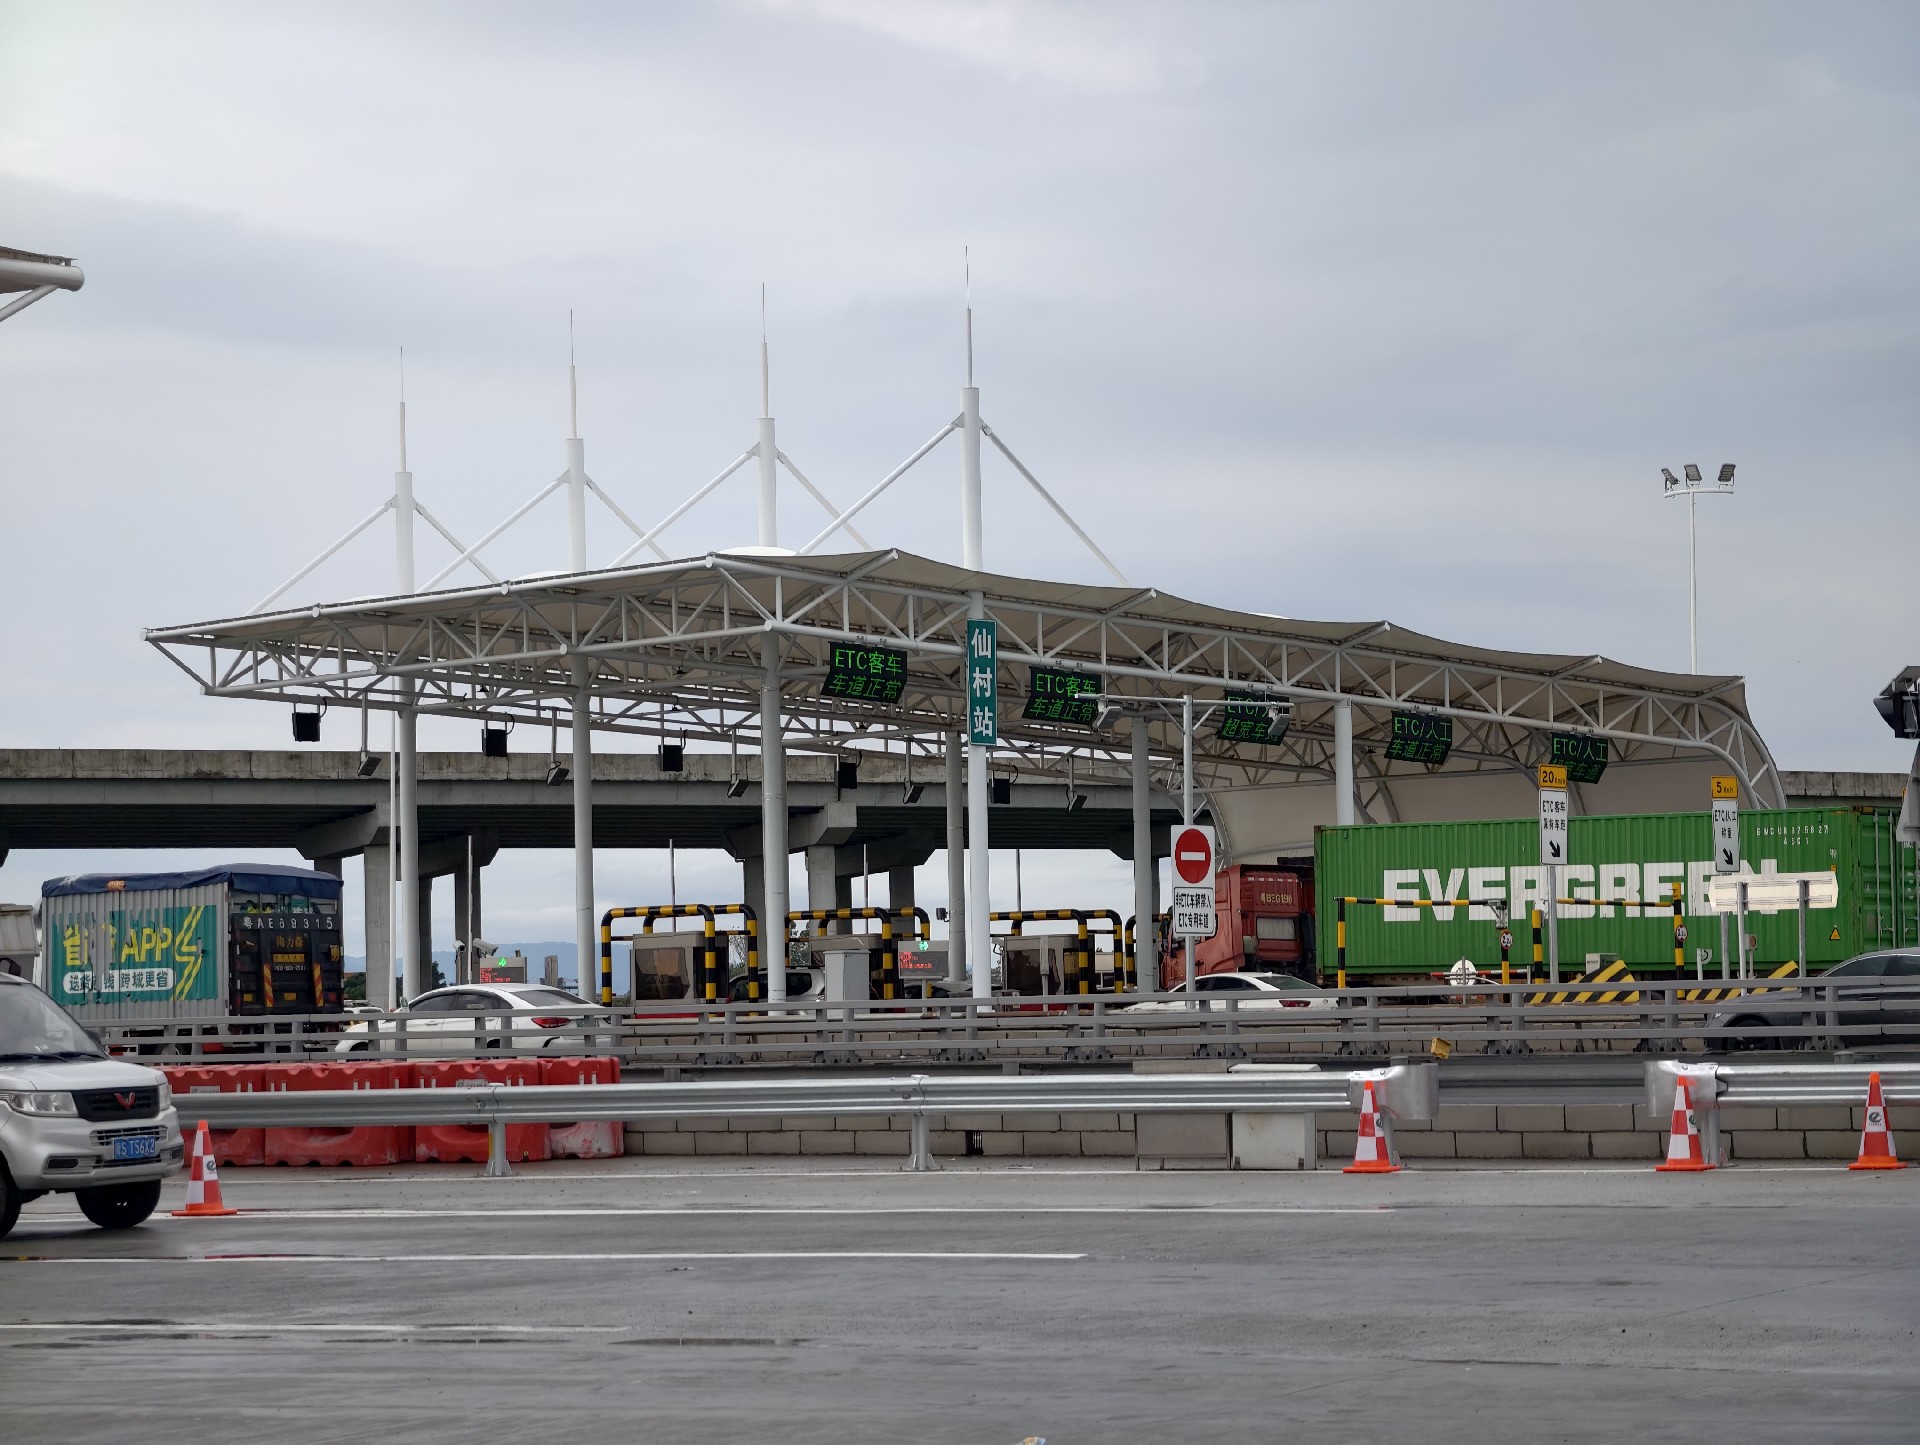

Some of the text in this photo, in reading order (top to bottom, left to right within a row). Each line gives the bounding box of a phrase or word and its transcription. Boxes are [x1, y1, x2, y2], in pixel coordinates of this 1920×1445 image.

[835, 648, 903, 675] ETC客车
[828, 673, 902, 699] 车道正常
[971, 627, 993, 737] 仙村站
[1036, 673, 1096, 695] ETC客车
[1029, 697, 1096, 721] 车道正常
[1394, 716, 1452, 741] ETC/人工
[1389, 738, 1446, 762] 车道正常
[1553, 737, 1608, 762] ETC/人工
[1543, 770, 1555, 784] 20
[1716, 781, 1723, 793] 5
[1178, 912, 1209, 928] ETC专用车道
